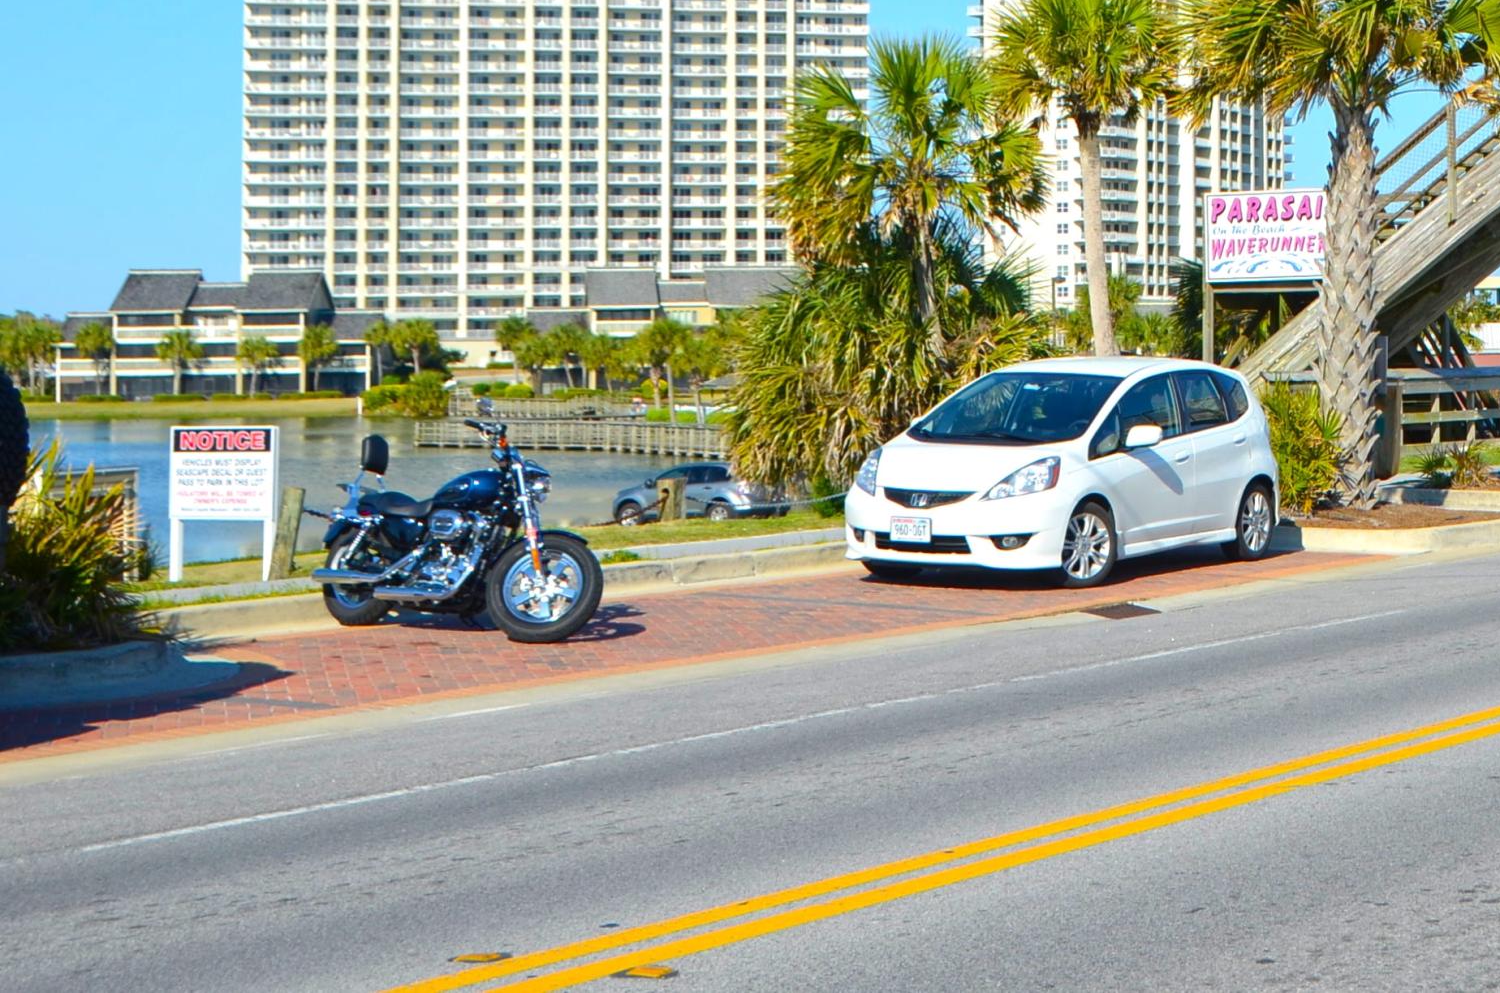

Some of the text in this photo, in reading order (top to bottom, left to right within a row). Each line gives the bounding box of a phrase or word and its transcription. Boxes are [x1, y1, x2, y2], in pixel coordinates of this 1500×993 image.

[1211, 195, 1323, 224] PARASAI
[1213, 226, 1226, 235] On
[1252, 224, 1286, 235] Beach
[180, 430, 266, 451] NOTICE
[182, 458, 262, 466] VEHICLES MUST DISPLAY
